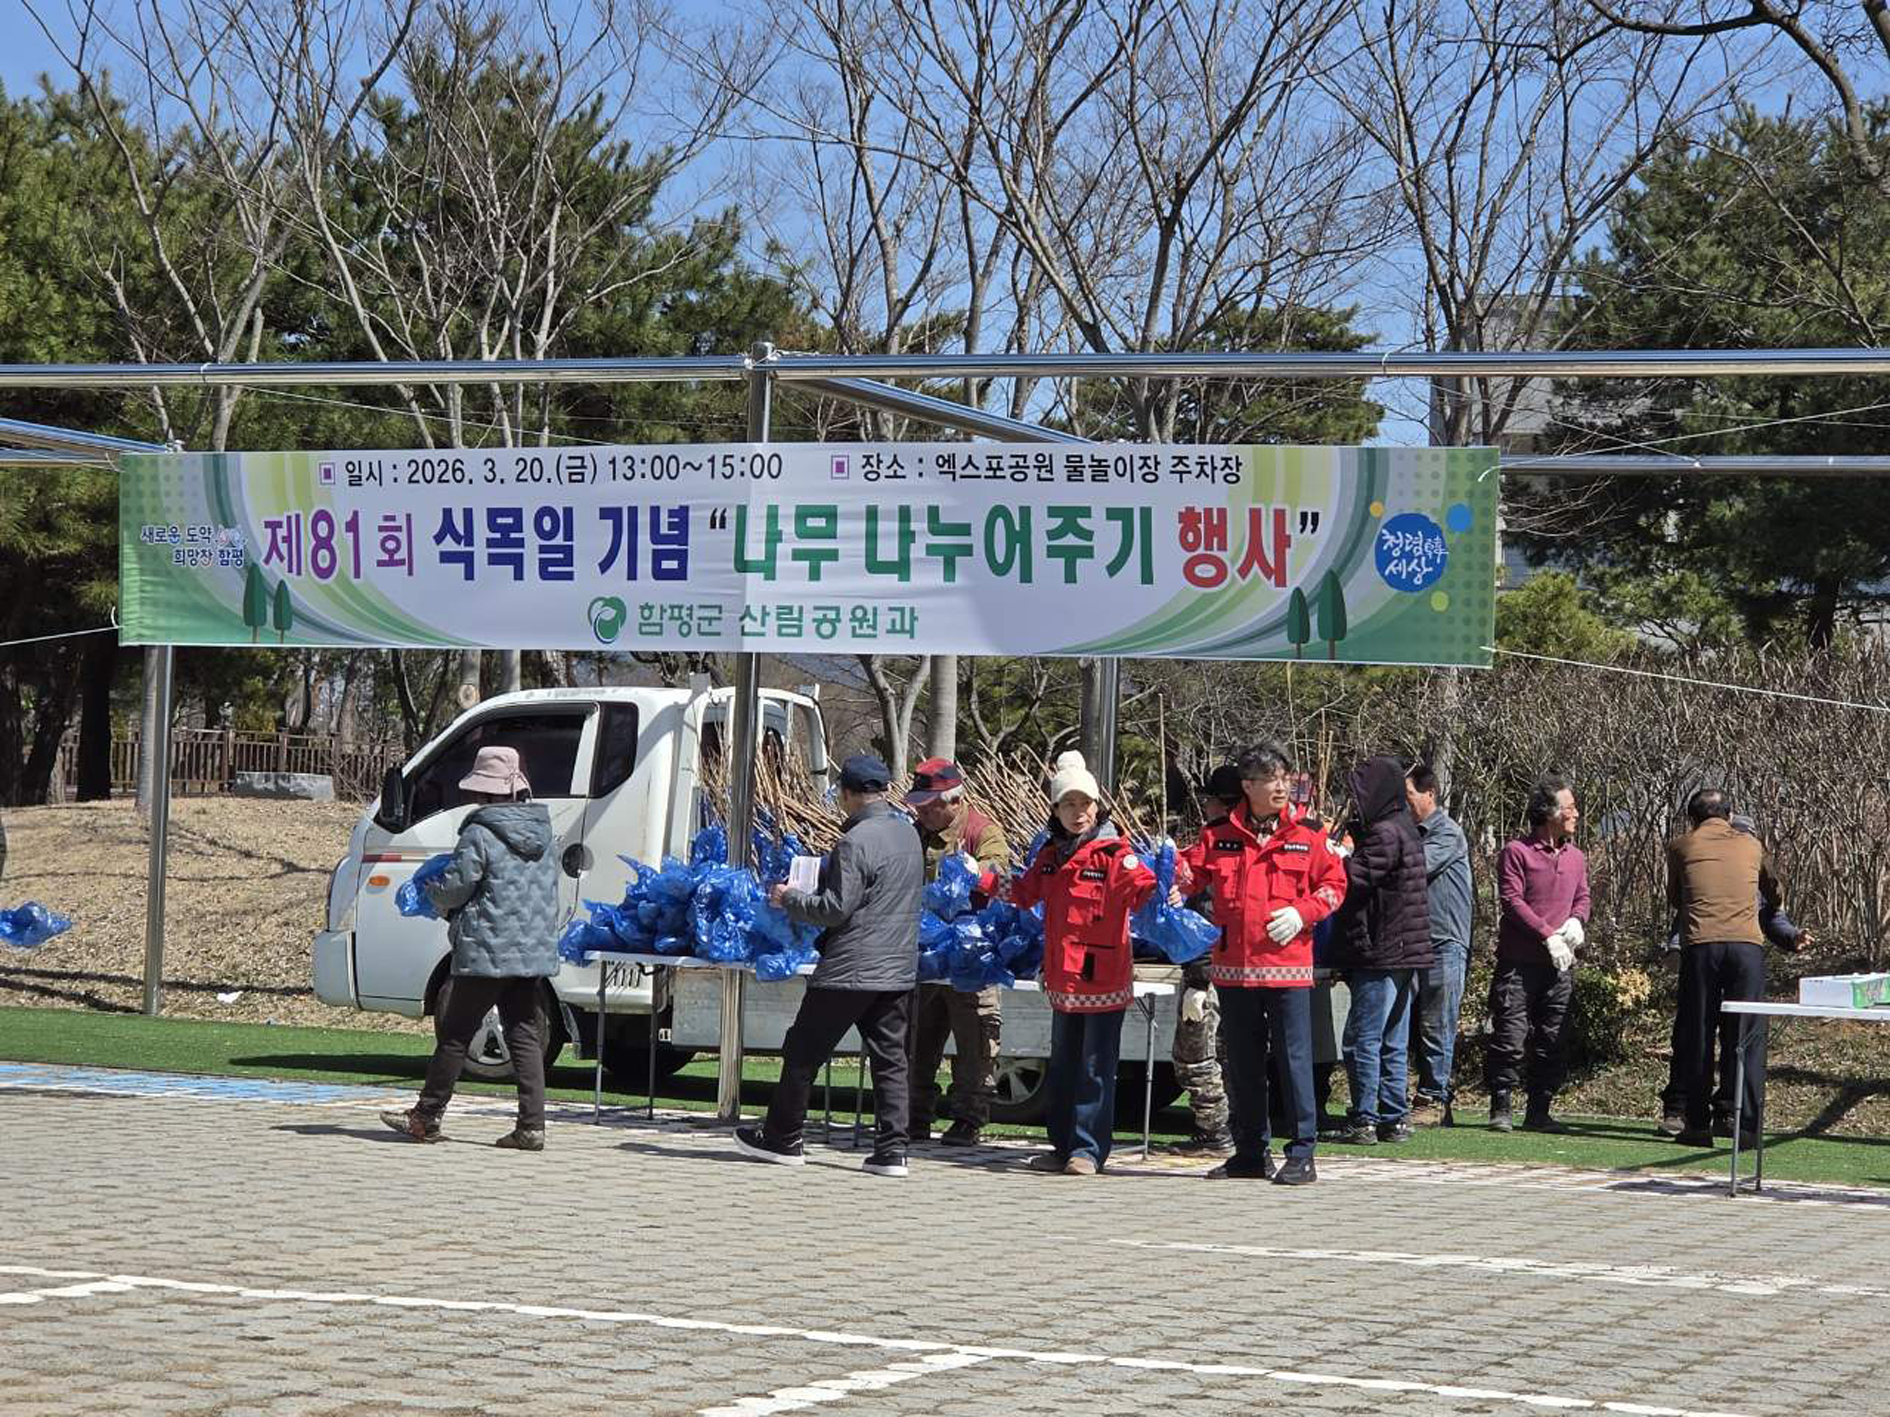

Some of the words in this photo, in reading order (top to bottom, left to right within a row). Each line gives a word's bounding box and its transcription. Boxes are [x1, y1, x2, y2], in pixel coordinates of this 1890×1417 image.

[345, 460, 383, 487] 일시
[407, 458, 473, 485] 2026.
[483, 457, 505, 484] 3.
[515, 453, 597, 486] 20.(금)
[608, 453, 783, 482] 13:00~15:00
[861, 453, 907, 481] 장소
[935, 453, 1055, 482] 엑스포공원
[1063, 454, 1161, 484] 물놀이장
[1169, 454, 1242, 485] 주차장
[141, 526, 181, 544] 새로운
[186, 526, 212, 544] 도약
[263, 508, 414, 580] 제81회
[432, 506, 575, 581] 식목일
[598, 505, 690, 581] 기념
[865, 504, 1154, 585] 나누어주기
[174, 548, 213, 567] 희망찬
[218, 548, 243, 567] 함평
[638, 602, 723, 637] 함평군
[739, 604, 919, 639] 산림공원과
